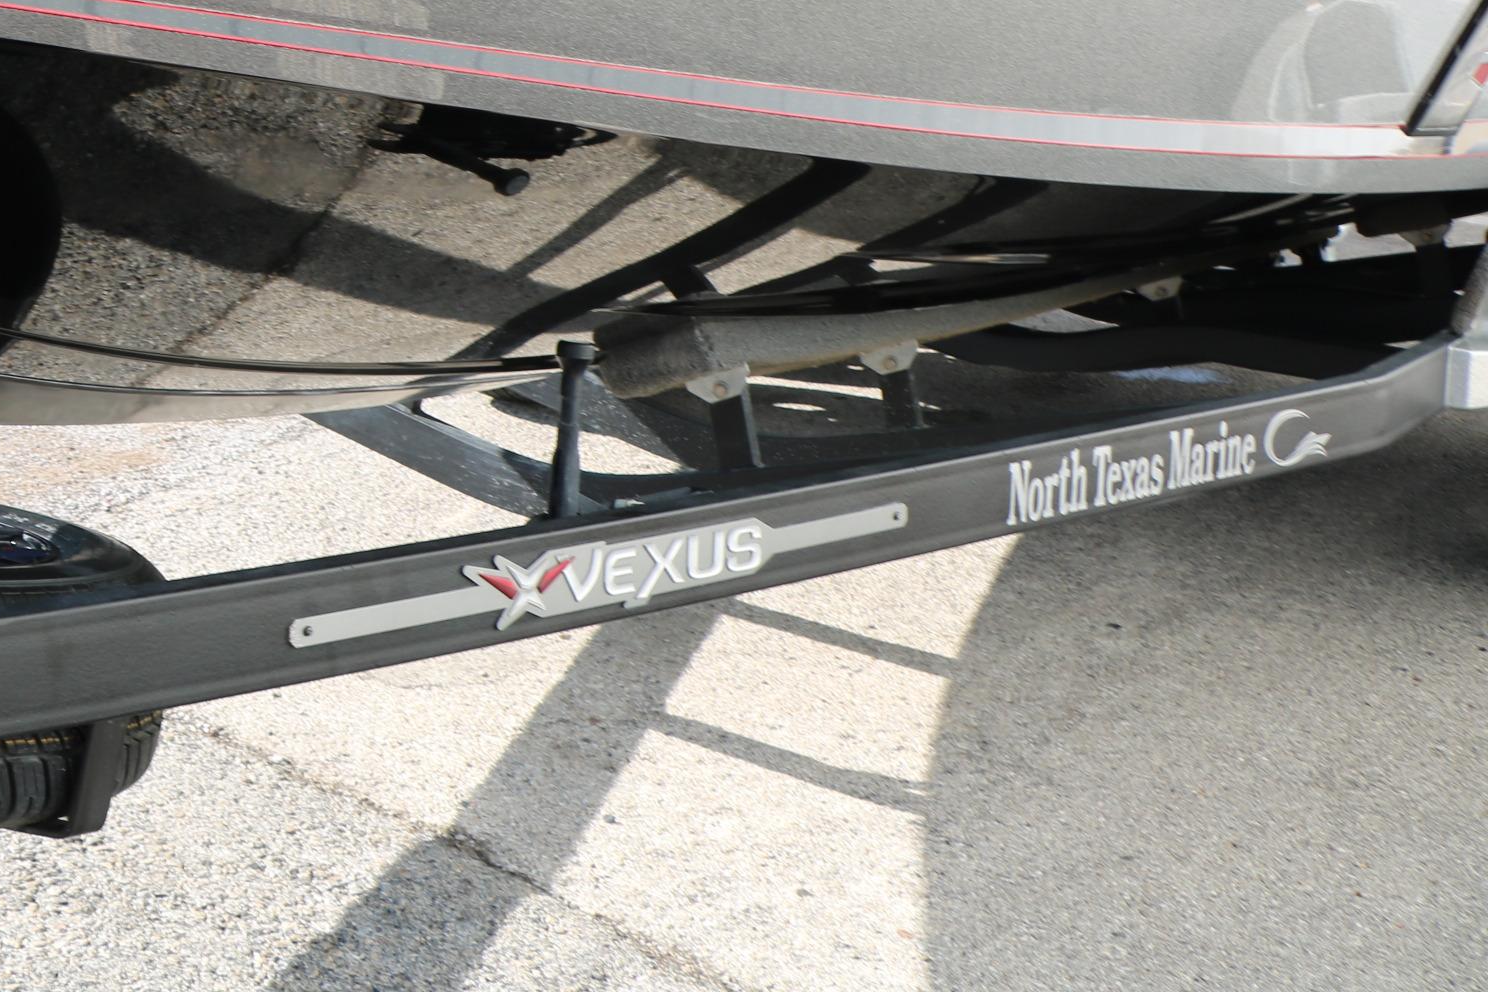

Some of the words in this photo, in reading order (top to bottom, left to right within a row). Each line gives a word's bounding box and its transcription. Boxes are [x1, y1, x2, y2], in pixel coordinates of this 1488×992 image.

[1006, 448, 1089, 526] North
[1092, 445, 1163, 506] Texas
[1167, 420, 1257, 490] Marine
[558, 525, 763, 603] VEXUS
